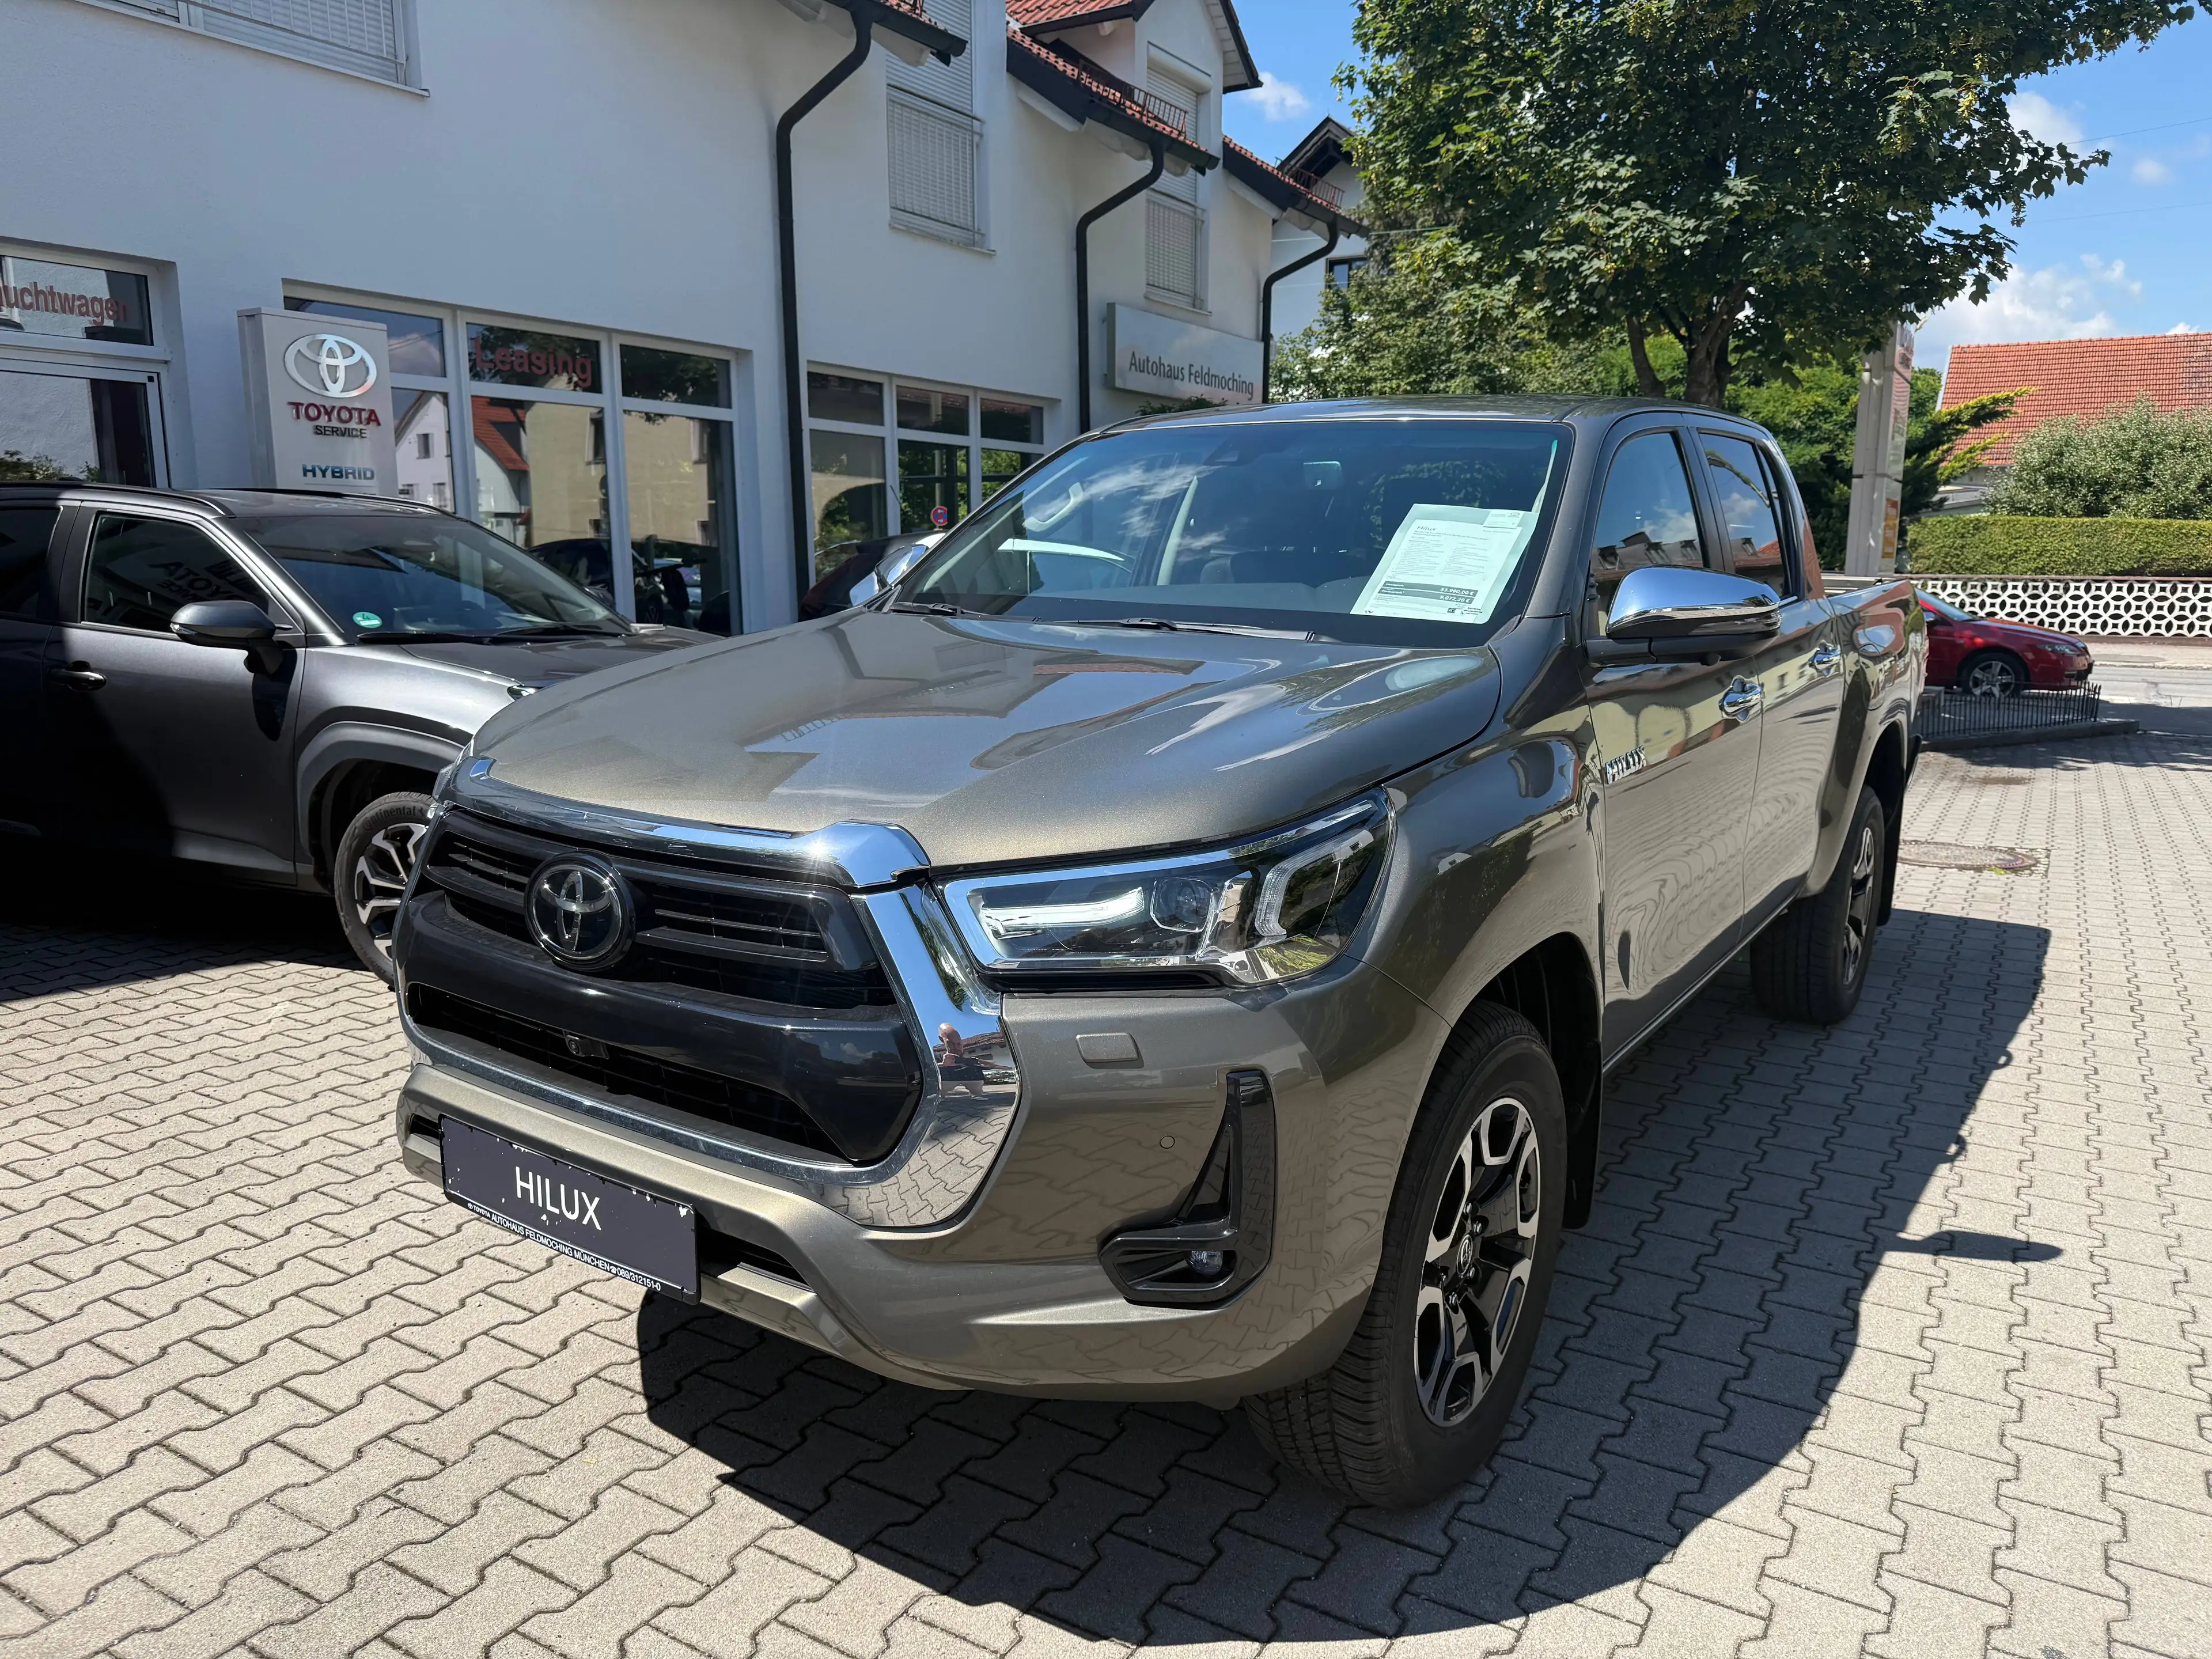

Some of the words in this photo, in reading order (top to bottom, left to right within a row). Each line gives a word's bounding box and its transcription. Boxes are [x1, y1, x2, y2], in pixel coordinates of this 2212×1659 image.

[0, 281, 132, 327] uchtwagen
[474, 335, 593, 388] Leasing
[1128, 350, 1185, 382] Autohaus
[1188, 363, 1254, 402] Feldmoching
[287, 401, 382, 427] TOYOTA
[314, 425, 368, 439] SERVICE
[302, 464, 376, 481] HYBRID
[363, 806, 416, 831] Continental
[515, 1166, 602, 1231] HILUX
[472, 1205, 491, 1218] TOYOTA
[491, 1213, 525, 1235] AUTOHAUS
[525, 1228, 573, 1256] FELDMOCHING
[574, 1249, 610, 1272] MÜNCHEN
[616, 1268, 662, 1291] 089/312151-0
